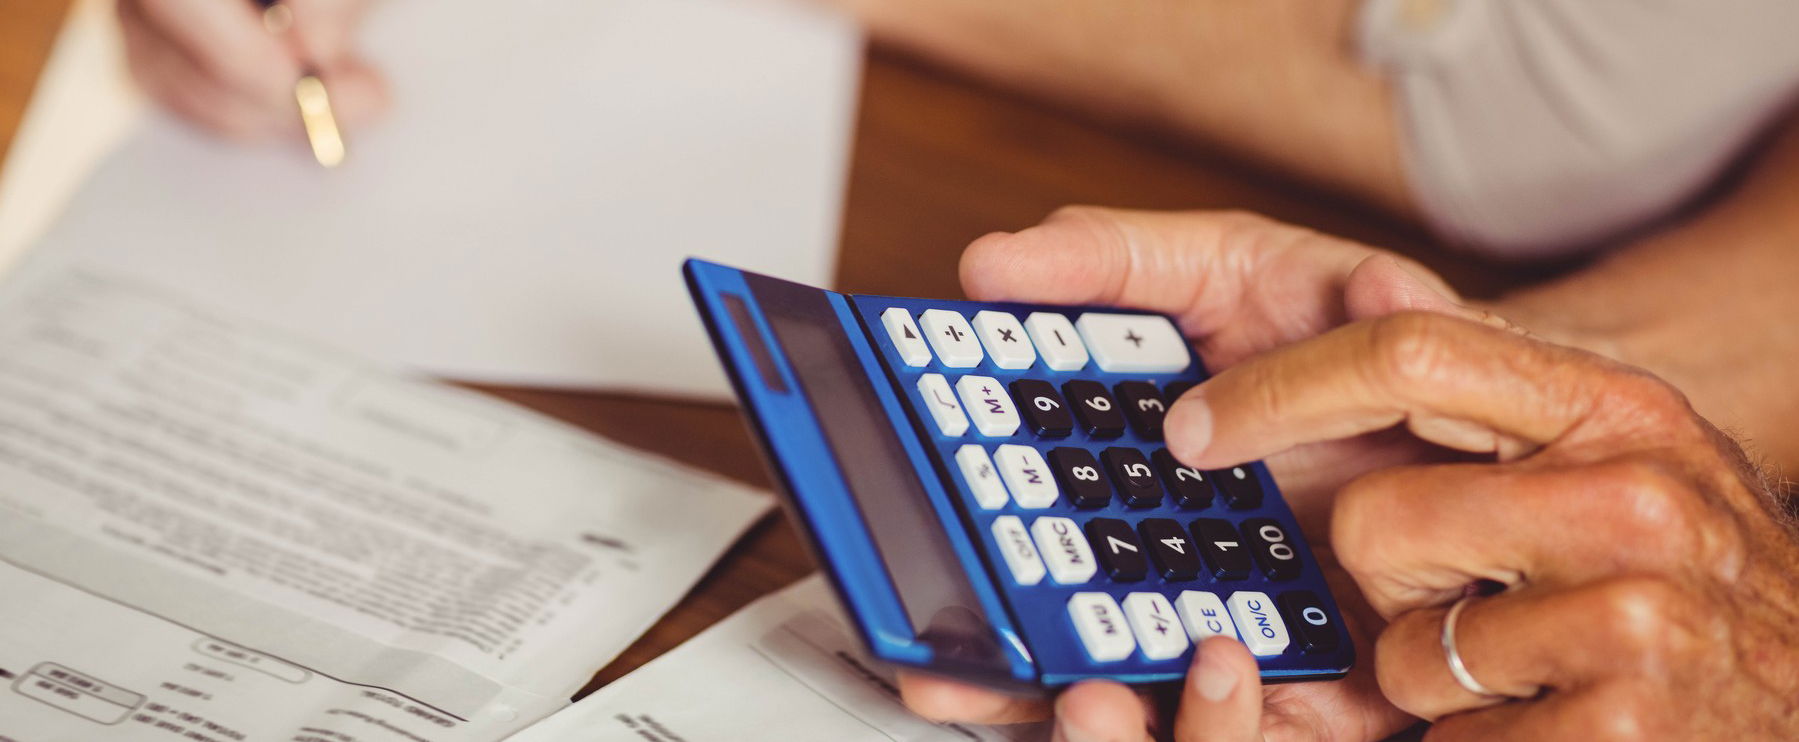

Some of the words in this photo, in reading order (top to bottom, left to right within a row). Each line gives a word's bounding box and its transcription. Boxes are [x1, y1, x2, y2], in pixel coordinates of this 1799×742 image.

[980, 385, 1006, 414] M+
[1033, 396, 1060, 412] 9
[1085, 396, 1112, 412] 6
[1138, 398, 1165, 413] 3
[1022, 455, 1043, 485] M-
[1072, 465, 1099, 482] 8
[1123, 463, 1152, 478] 5
[1175, 466, 1204, 482] 2
[1052, 521, 1084, 564] MRC
[1106, 535, 1139, 554] 7
[1160, 536, 1186, 555] 4
[1214, 541, 1239, 552] 1
[1259, 525, 1295, 560] 00
[1200, 608, 1223, 633] CE
[1247, 599, 1276, 639] ON/C
[1302, 606, 1328, 626] 0
